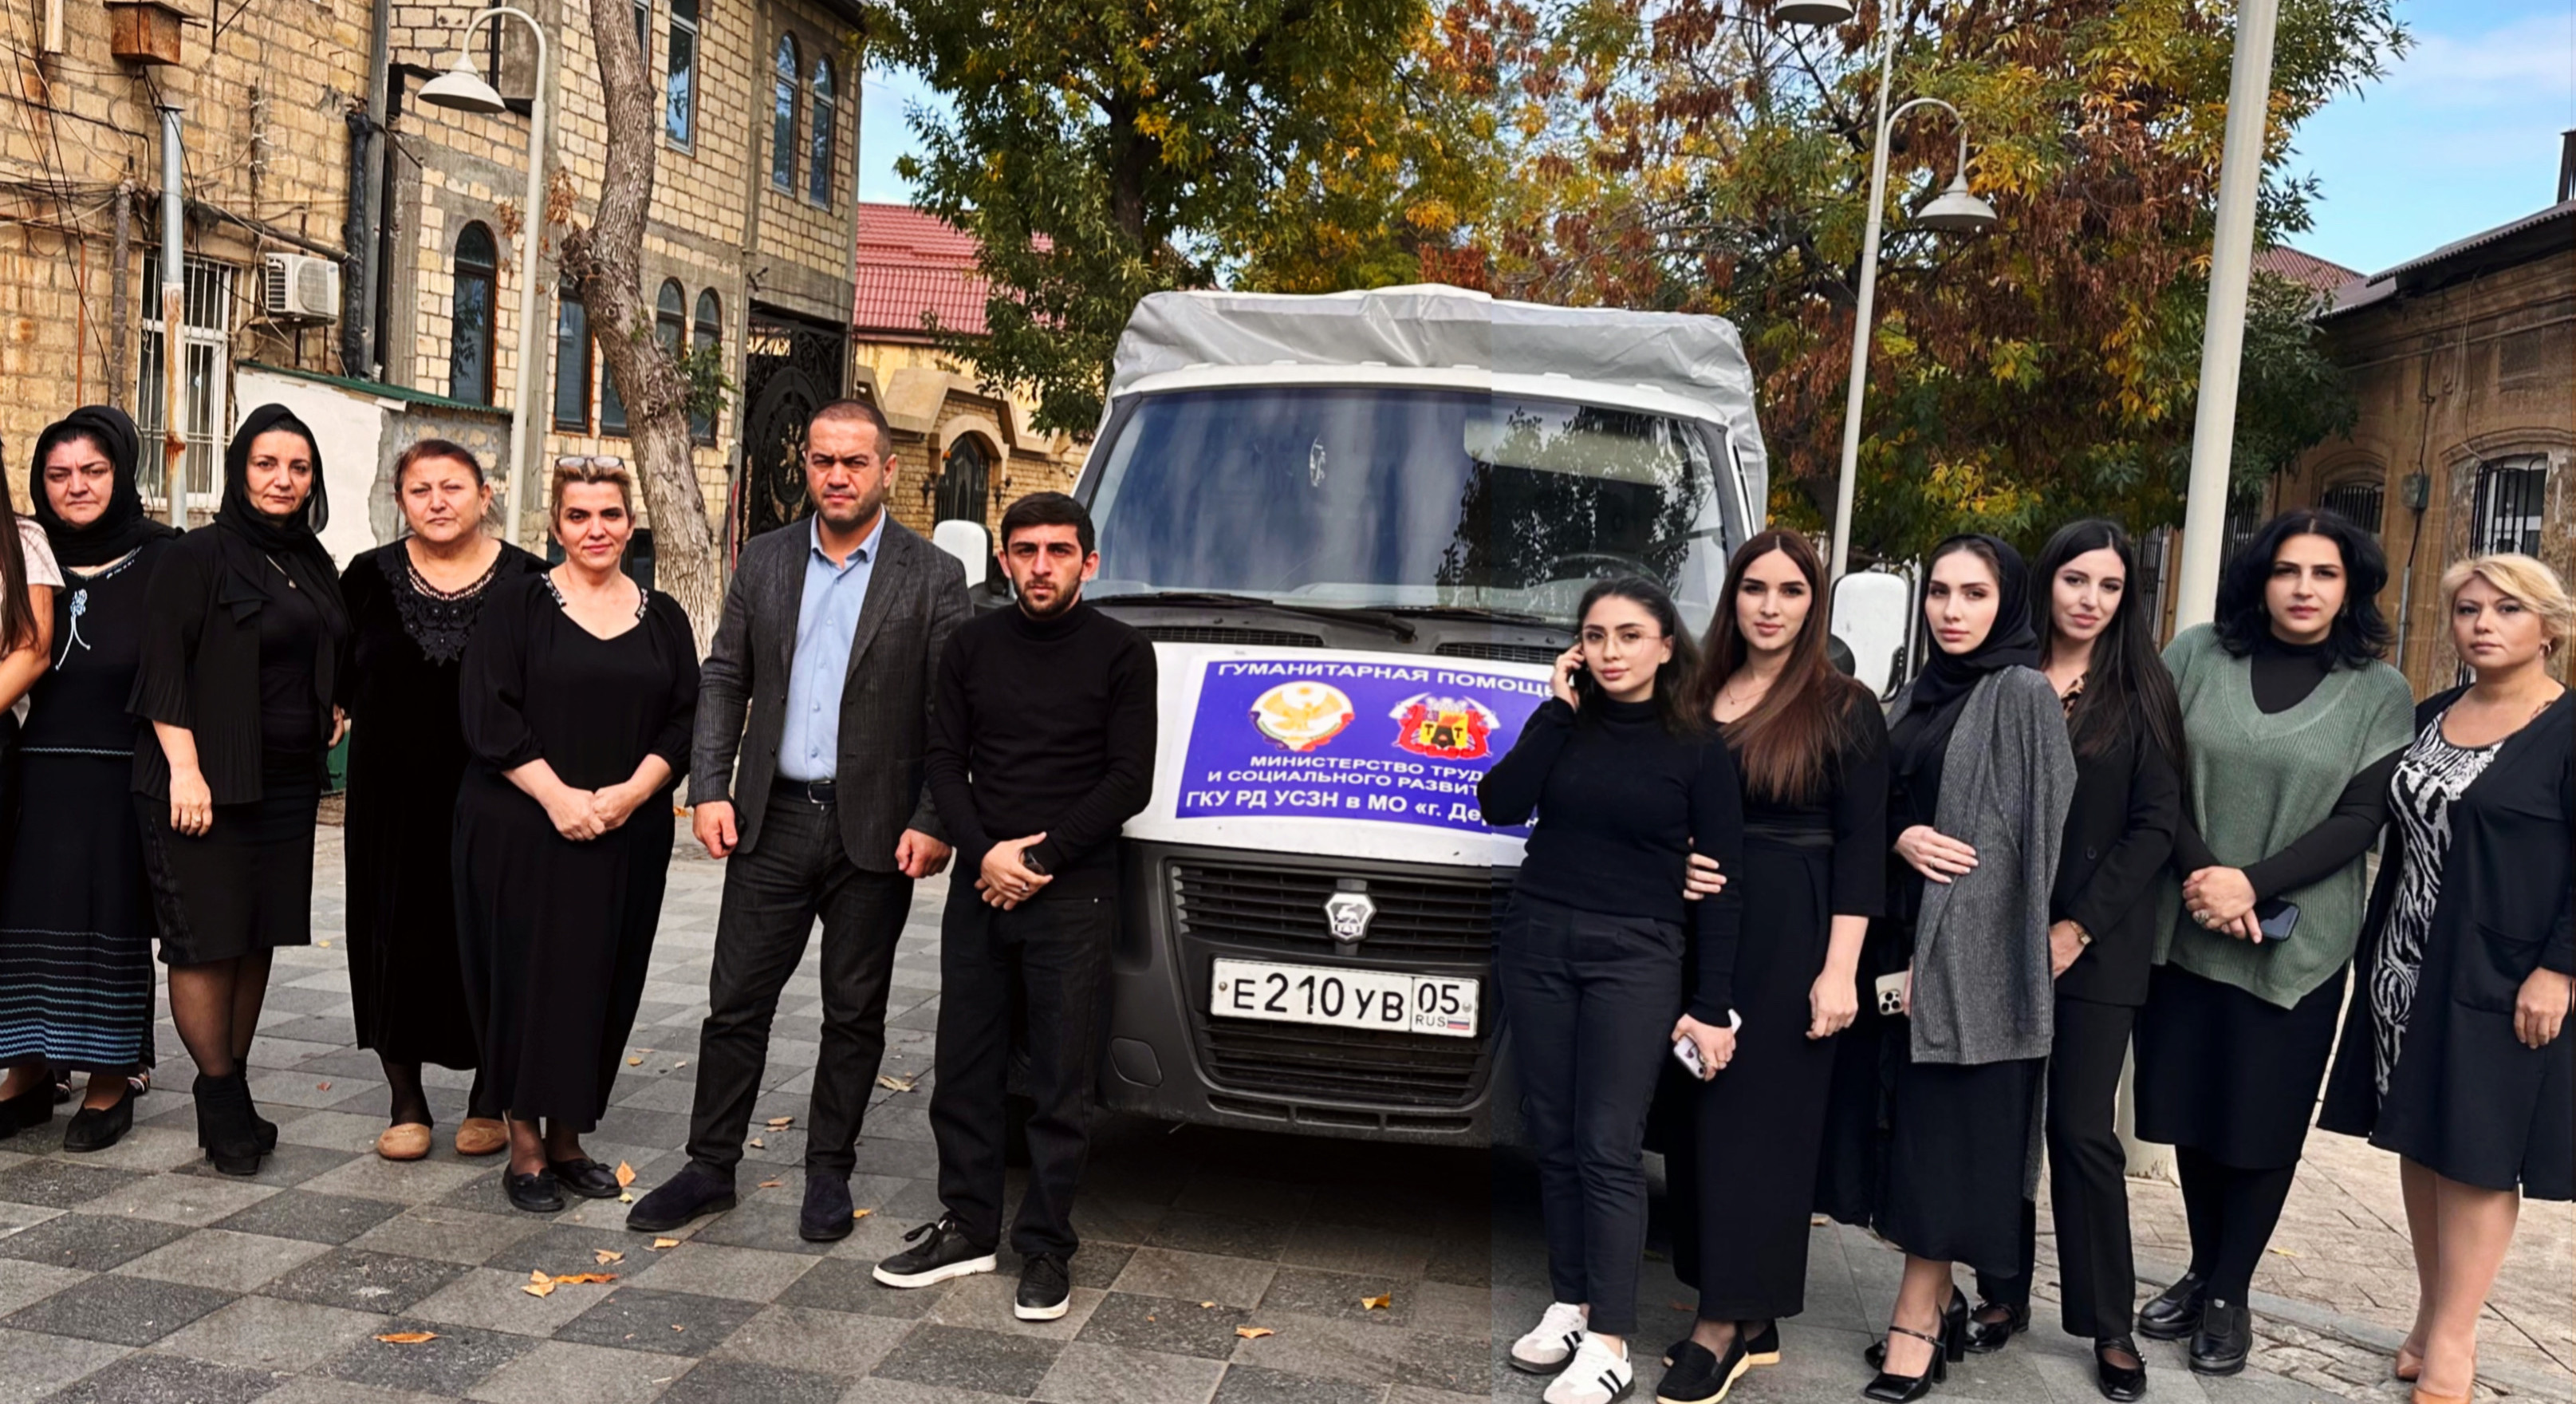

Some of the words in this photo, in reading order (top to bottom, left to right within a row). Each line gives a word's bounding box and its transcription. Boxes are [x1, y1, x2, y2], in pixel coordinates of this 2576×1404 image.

[1218, 663, 1429, 683] ГУМАНИТАРНАЯ
[1250, 755, 1424, 775] МИНИСТЕРСТВО
[1430, 765, 1484, 783] ТРУД
[1207, 771, 1222, 782] И
[1227, 770, 1392, 786] СОЦИАЛЬНОГО
[1397, 777, 1478, 797] РАЗВИТ
[1185, 791, 1231, 807] ГКУ
[1235, 790, 1267, 809] РД
[1274, 790, 1339, 807] УСЗН
[1345, 796, 1361, 809] в
[1367, 794, 1408, 813] МО
[1415, 803, 1441, 817] «г.
[1418, 982, 1460, 1016] 05
[1415, 1014, 1446, 1027] RUS
